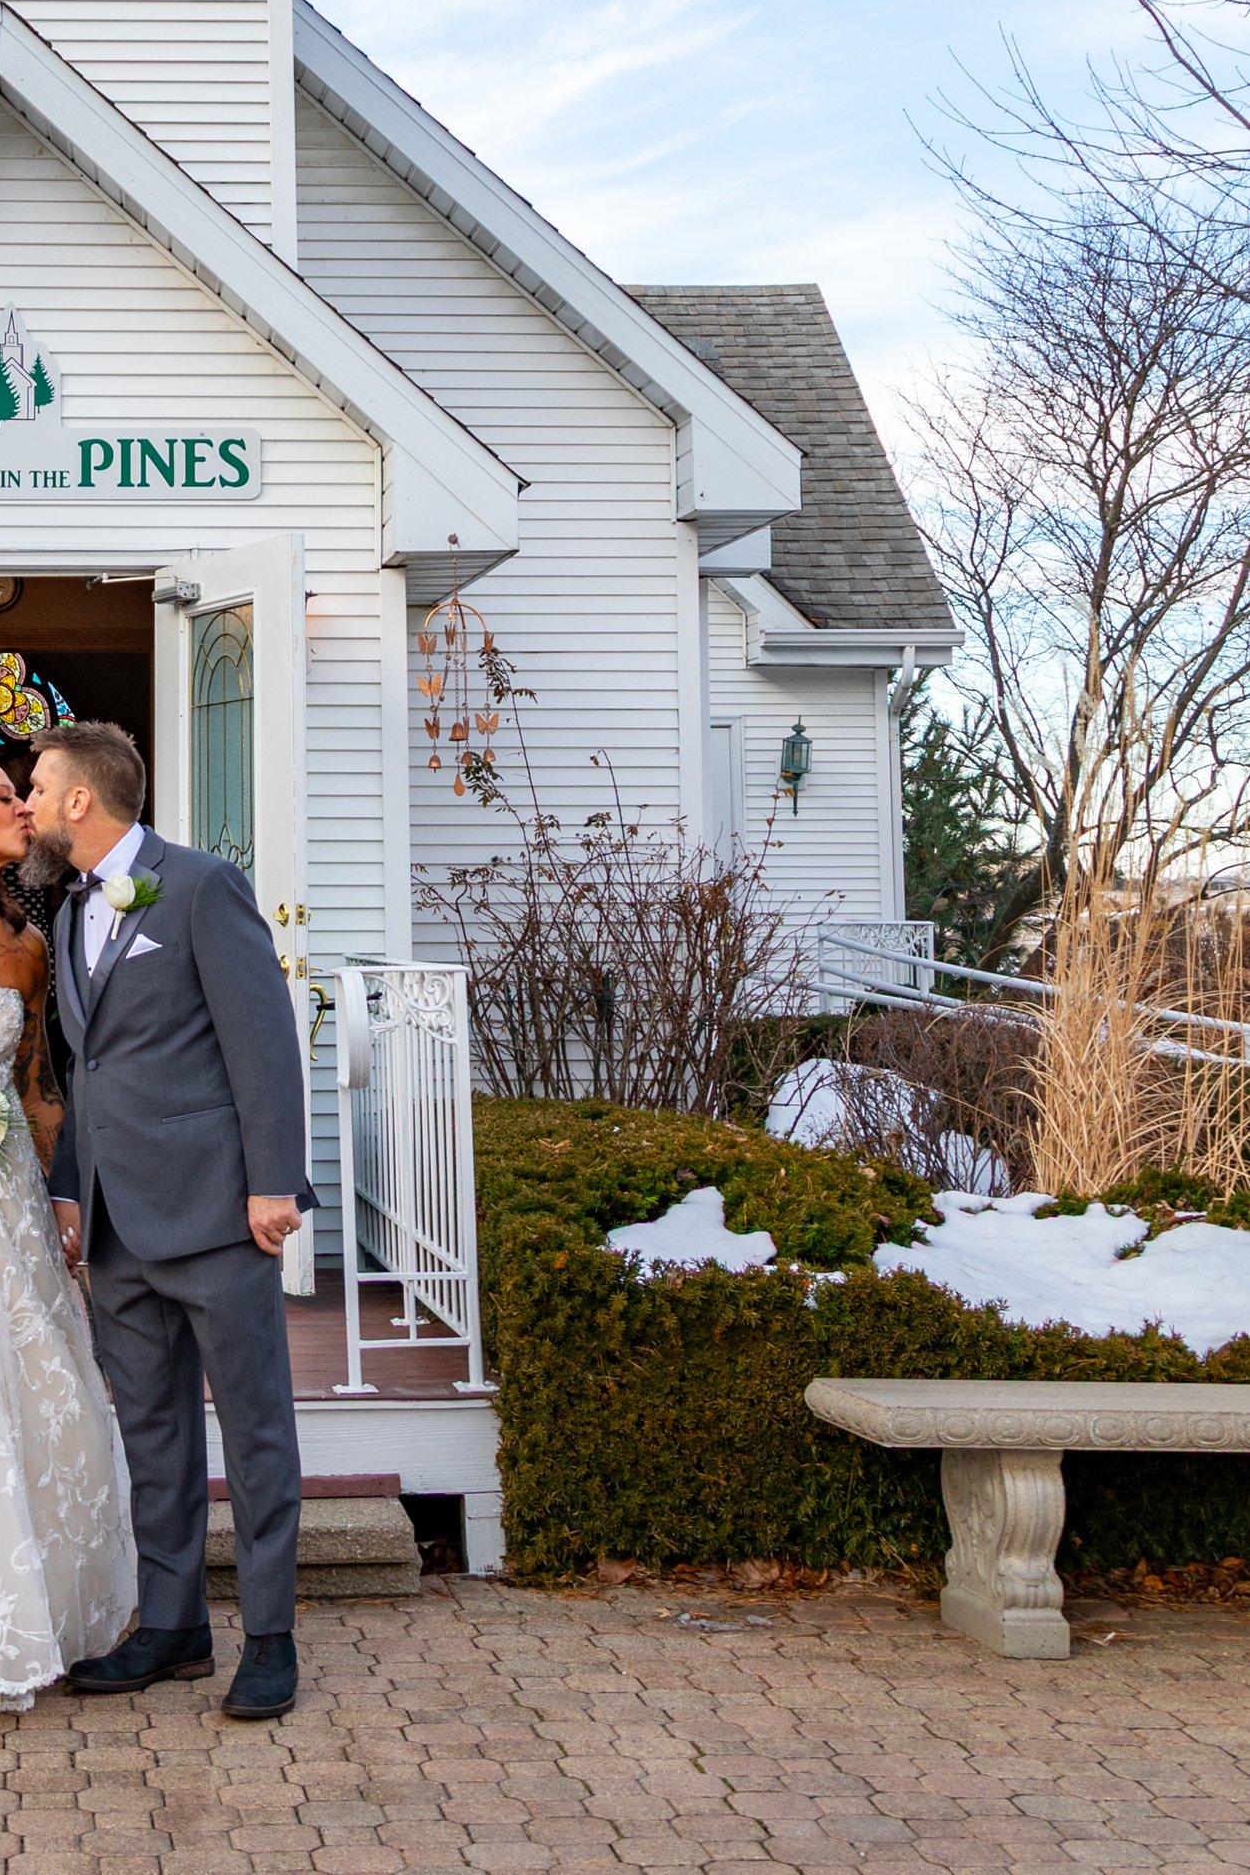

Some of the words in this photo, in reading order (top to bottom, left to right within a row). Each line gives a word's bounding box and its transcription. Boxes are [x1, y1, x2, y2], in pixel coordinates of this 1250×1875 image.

[0, 471, 22, 488] IN
[29, 470, 70, 489] THE
[78, 438, 250, 489] PINES
